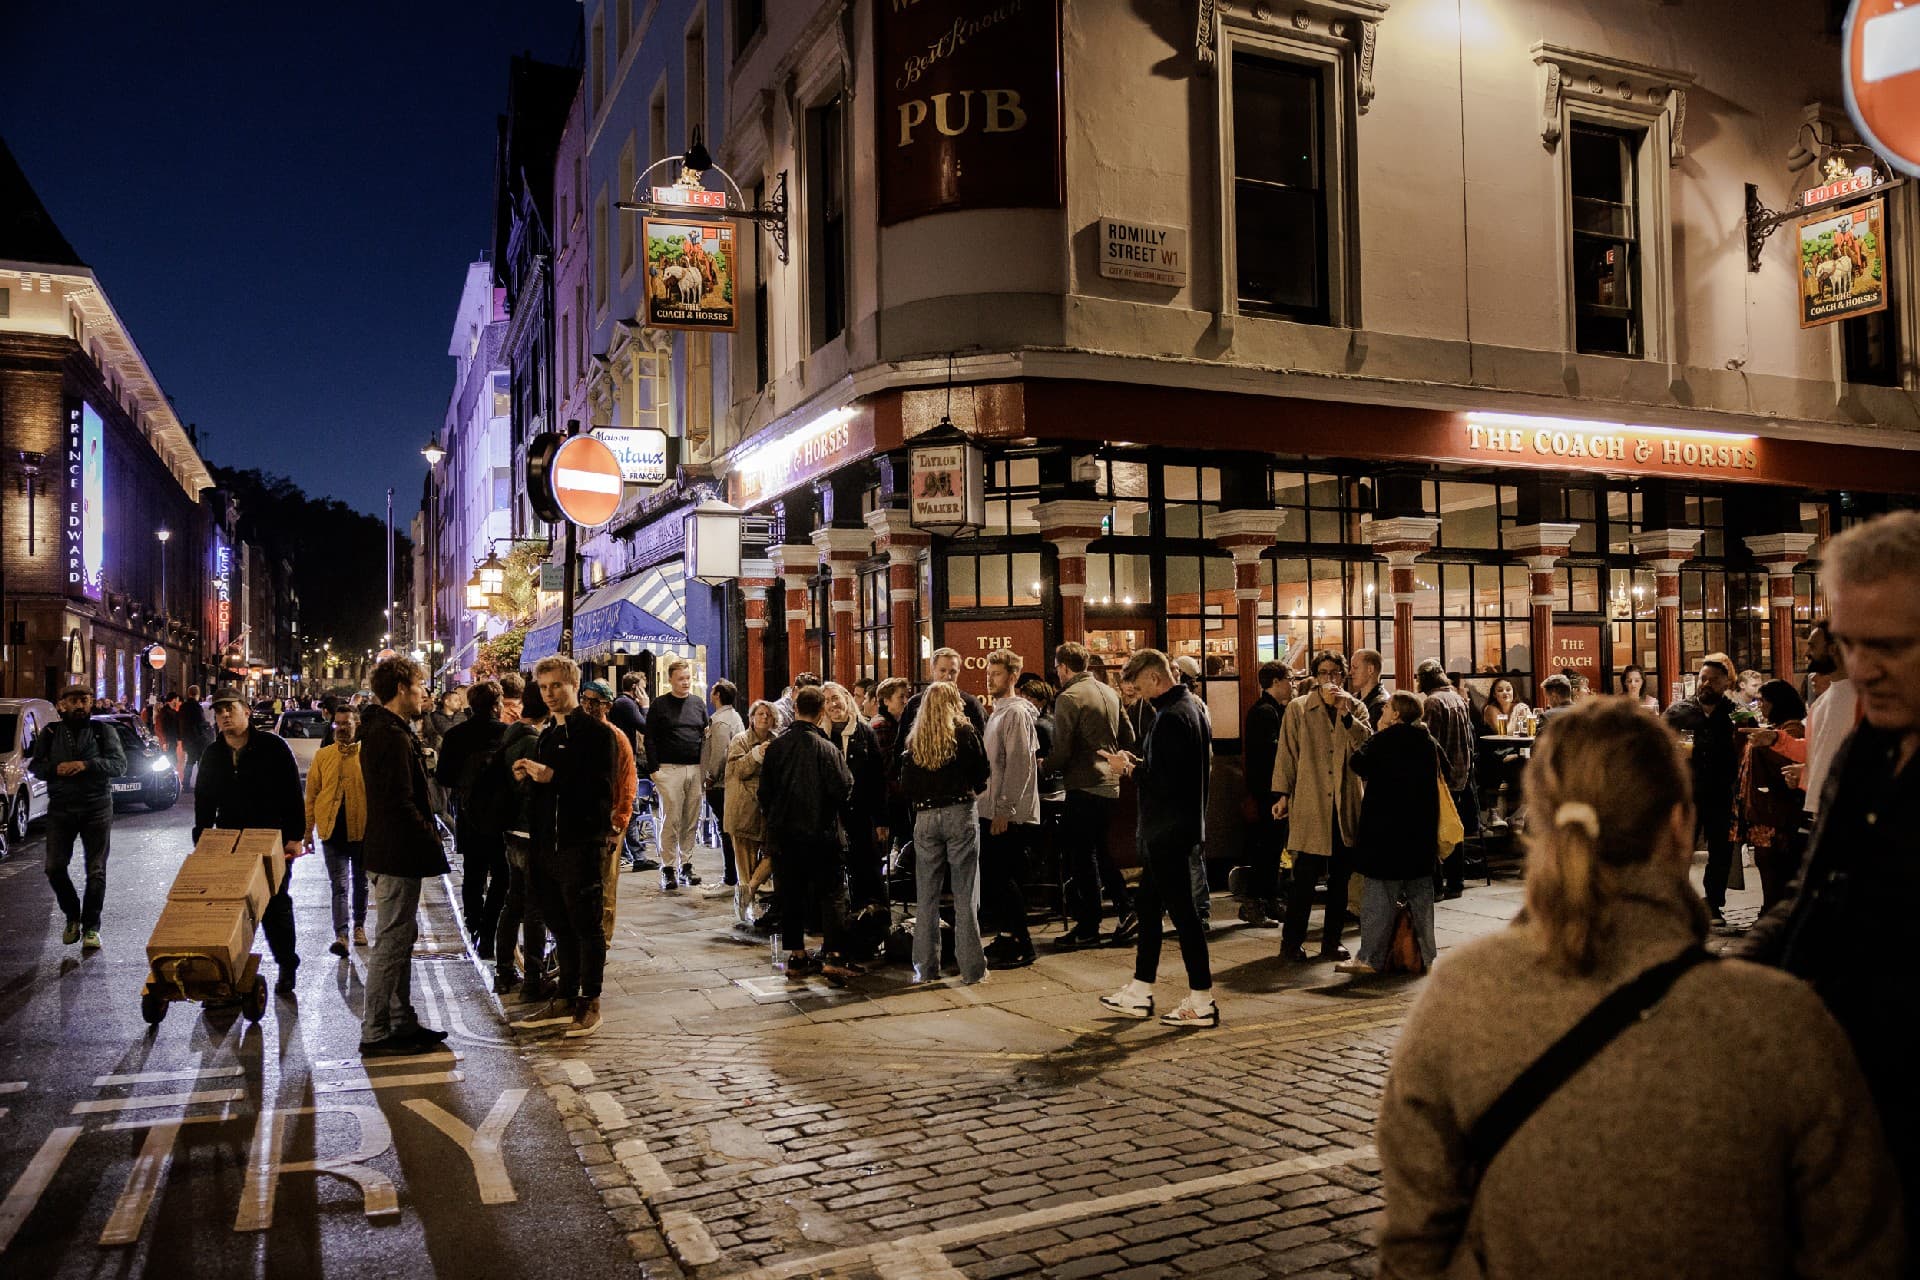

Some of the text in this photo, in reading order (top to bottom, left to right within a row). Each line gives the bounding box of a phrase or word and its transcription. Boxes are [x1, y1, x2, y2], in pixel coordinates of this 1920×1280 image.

[896, 36, 944, 89] Best
[898, 89, 1028, 148] PUB
[1806, 176, 1869, 204] FULLER'S
[1108, 223, 1166, 246] ROMILLY
[1108, 242, 1178, 267] STREET W1
[1108, 266, 1123, 275] CITY
[656, 310, 728, 321] COACH & HORSES
[1810, 292, 1878, 317] COACH & HORSES
[804, 423, 849, 467] HORSES
[1465, 423, 1758, 470] THE COACH & HORSES
[916, 454, 956, 468] TAYLOR
[67, 409, 82, 583] PRINCE EDWARD
[916, 501, 960, 514] WALKER
[977, 636, 1013, 649] THE
[1560, 638, 1585, 650] THE
[1552, 655, 1593, 667] COACH
[0, 1089, 530, 1250] TRY
